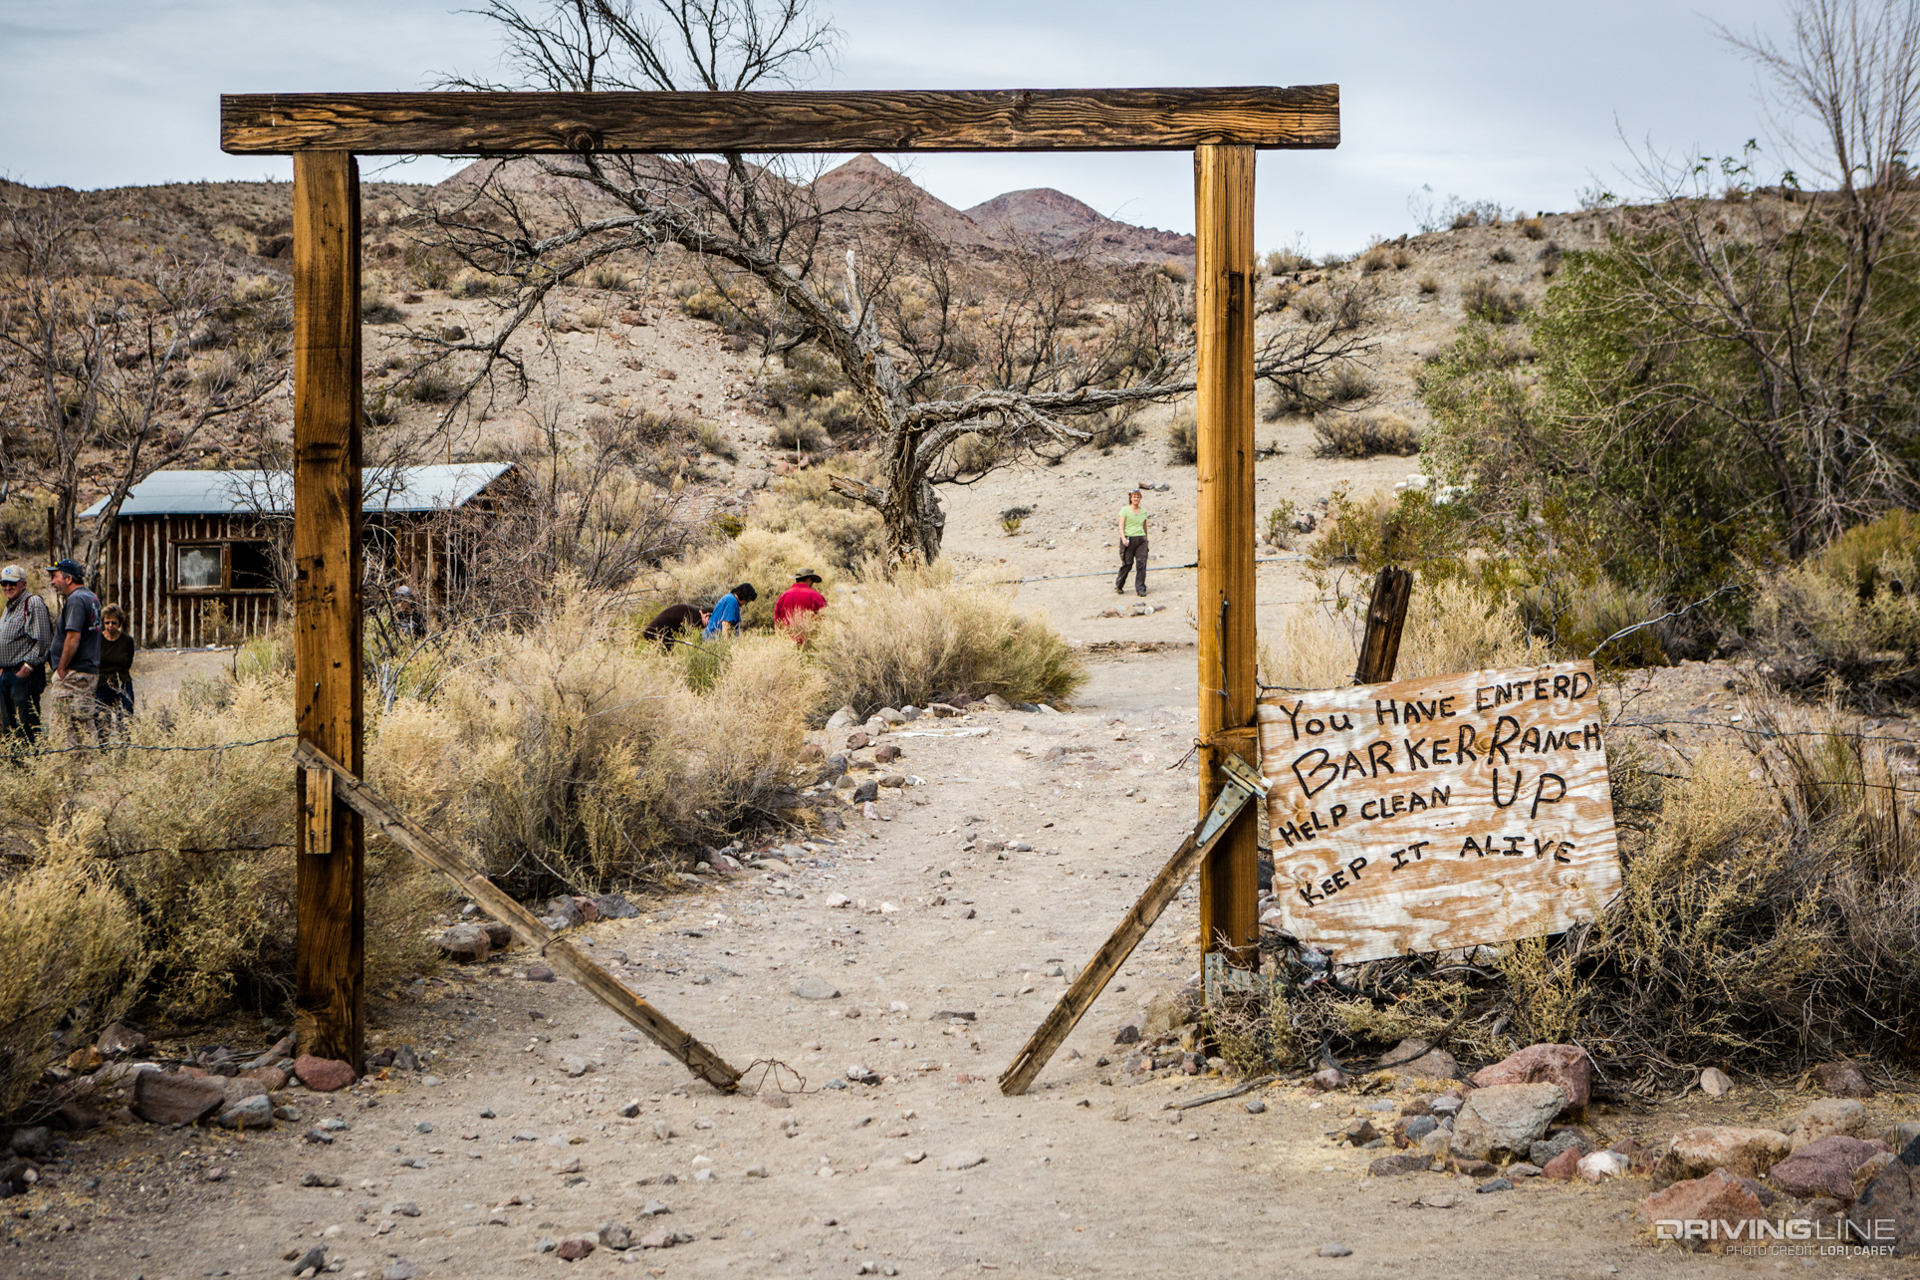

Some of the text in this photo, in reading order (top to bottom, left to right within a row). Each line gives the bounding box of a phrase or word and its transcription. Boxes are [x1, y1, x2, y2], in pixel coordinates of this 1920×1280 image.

[1376, 696, 1456, 725] HAVE
[1476, 672, 1593, 713] ENTERD
[1291, 715, 1602, 799] BARKER RANCH
[1278, 768, 1567, 848] HELP CLEAN UP
[1299, 835, 1576, 907] KEEP IT ALIVE
